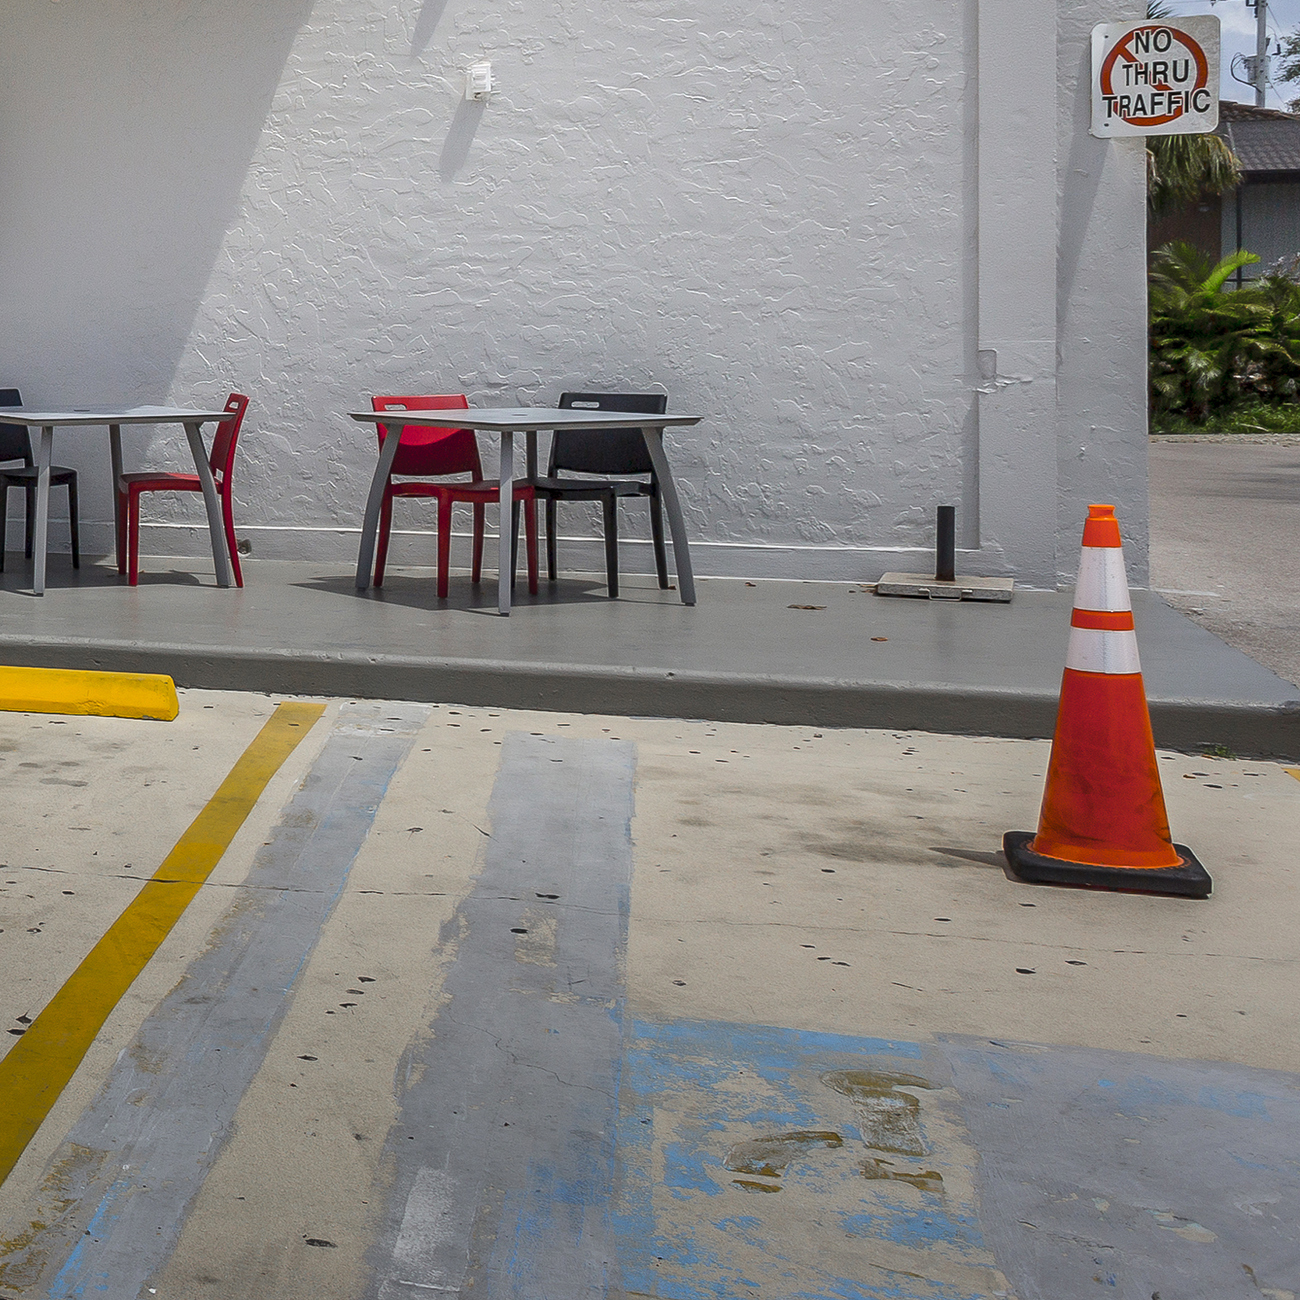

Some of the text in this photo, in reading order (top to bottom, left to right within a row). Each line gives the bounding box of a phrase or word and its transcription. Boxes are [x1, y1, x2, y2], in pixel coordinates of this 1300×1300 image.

[1134, 28, 1172, 55] NO
[1122, 58, 1190, 87] THRU
[1101, 88, 1211, 119] TRAFFIC
